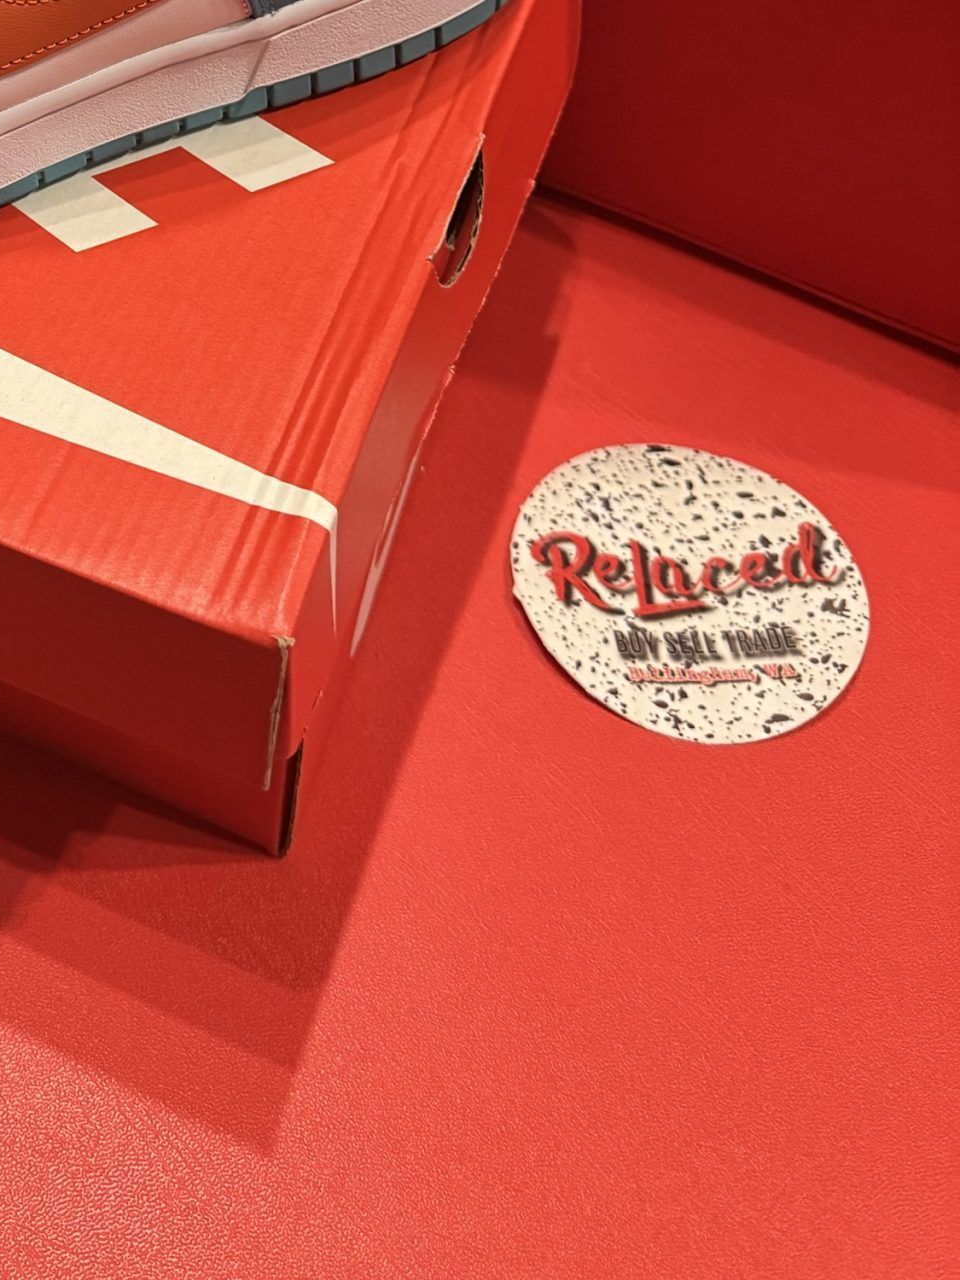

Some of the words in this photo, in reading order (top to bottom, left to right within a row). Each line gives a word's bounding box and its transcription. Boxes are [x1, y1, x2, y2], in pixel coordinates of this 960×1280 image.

[614, 629, 656, 657] BUY
[663, 628, 720, 657] SELL
[722, 626, 797, 655] TRADE
